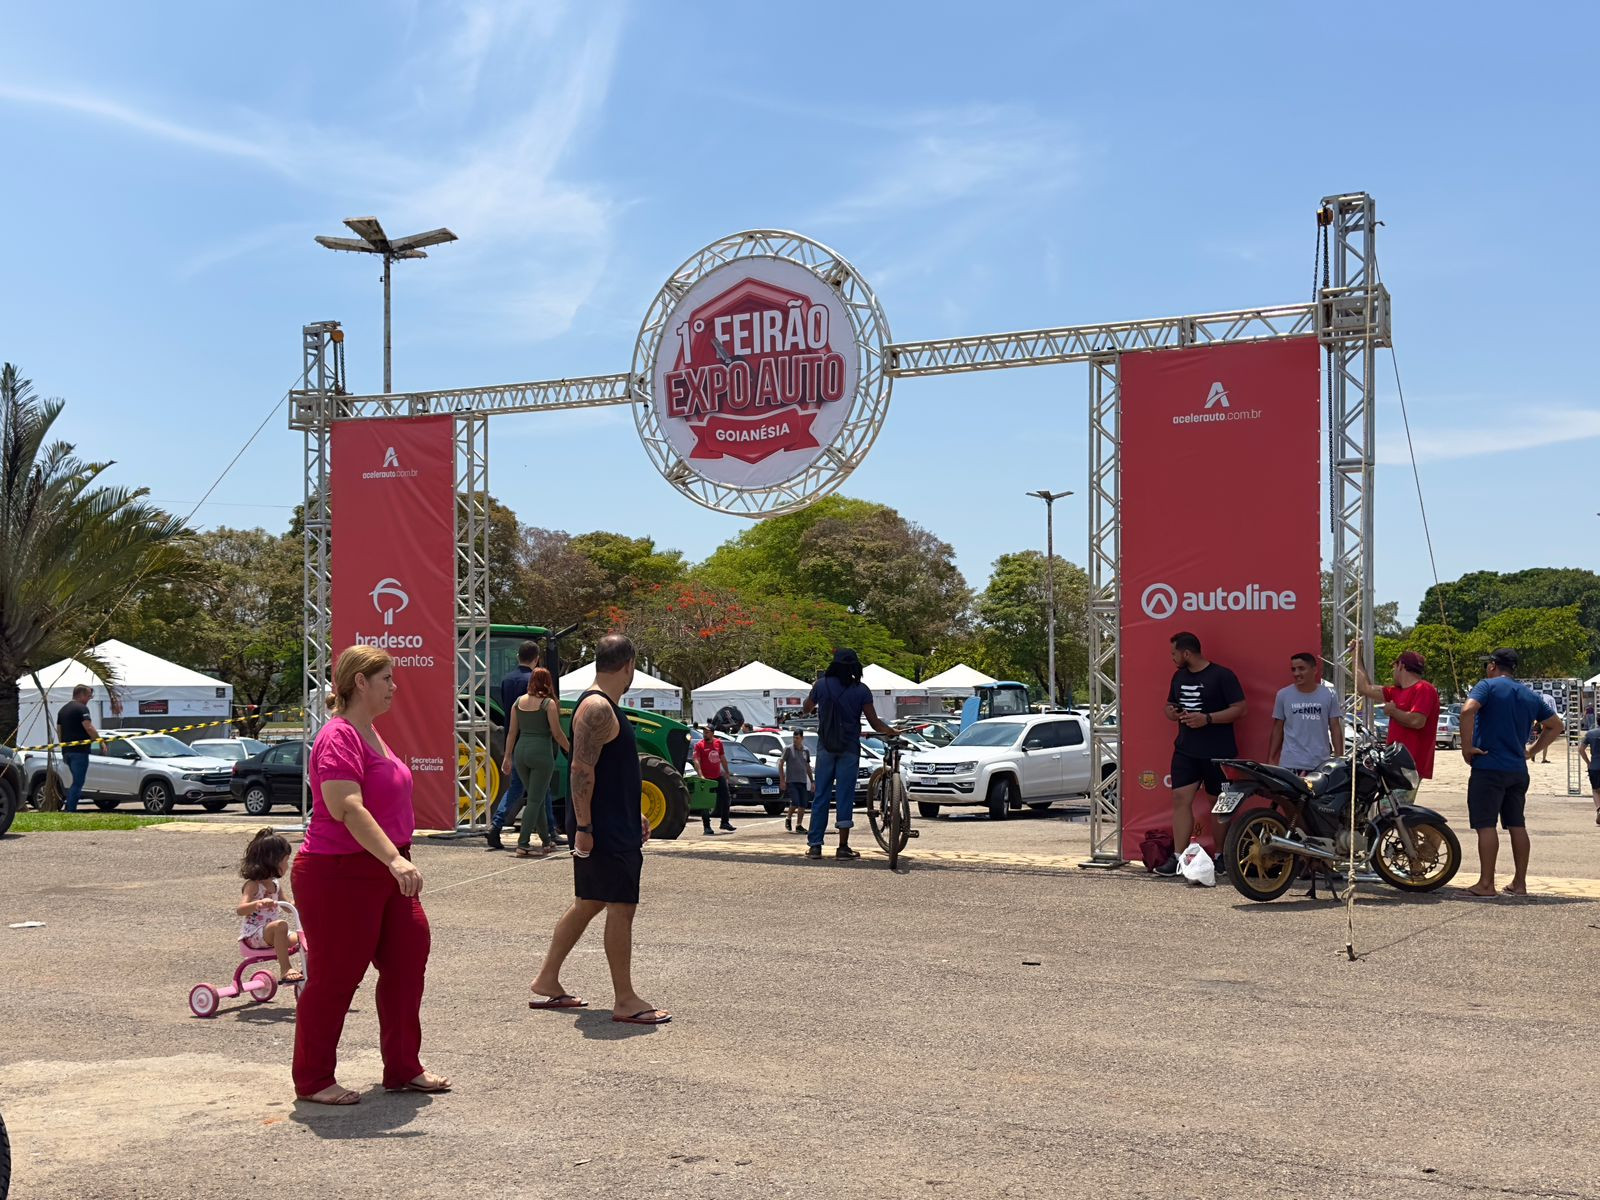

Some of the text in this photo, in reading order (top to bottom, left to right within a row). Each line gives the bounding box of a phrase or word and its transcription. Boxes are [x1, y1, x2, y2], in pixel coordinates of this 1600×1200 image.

[714, 299, 829, 358] FEIRÃO
[664, 352, 846, 418] EXPO AUTO
[1172, 408, 1262, 424] acelerauto.com.br
[715, 422, 790, 442] GOIANÉSIA
[1182, 583, 1297, 612] autoline
[355, 631, 423, 649] bradesco
[410, 756, 444, 764] Secretaria
[410, 763, 419, 771] de
